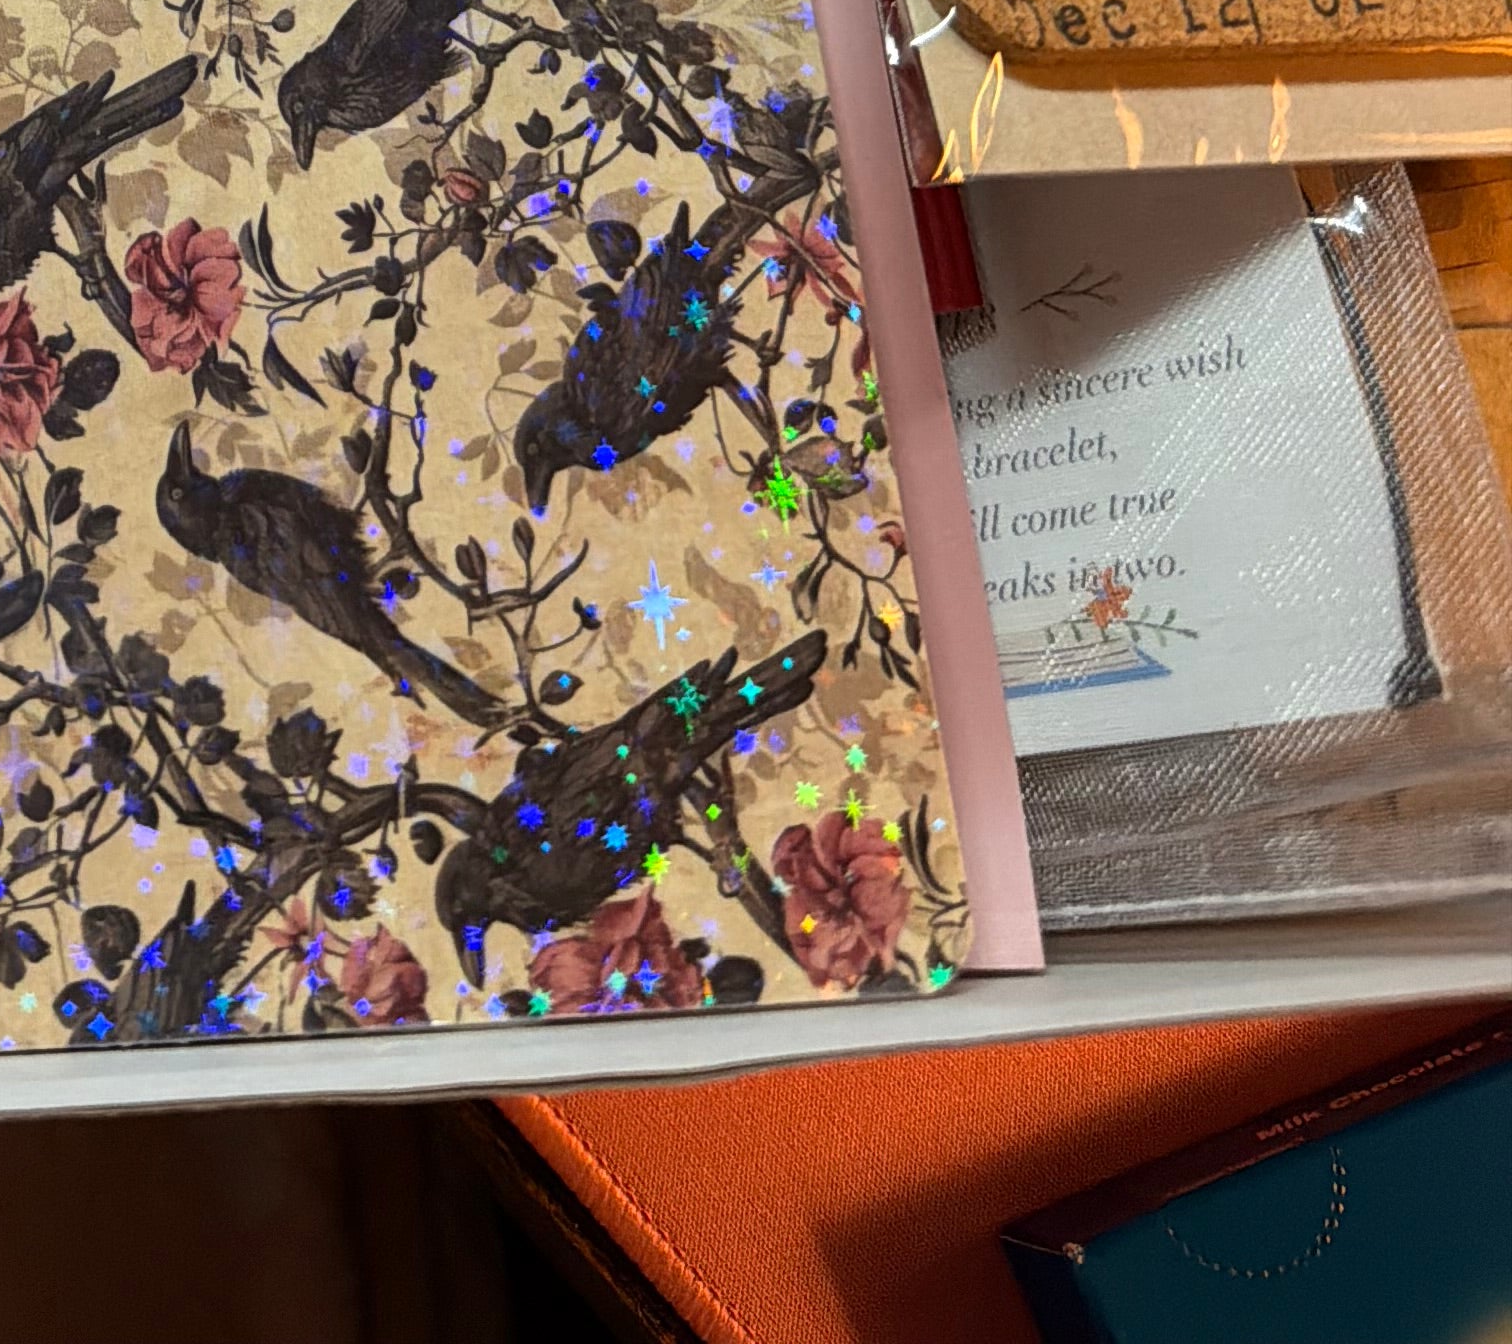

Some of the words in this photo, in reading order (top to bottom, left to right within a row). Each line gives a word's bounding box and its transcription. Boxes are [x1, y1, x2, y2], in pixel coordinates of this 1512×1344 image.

[1037, 363, 1155, 407] sincere
[1165, 333, 1248, 382] wish
[972, 425, 1119, 480] bracelet,
[1010, 500, 1097, 535] come
[1108, 486, 1176, 522] true
[982, 560, 1056, 606] eaks
[1112, 553, 1186, 584] two.
